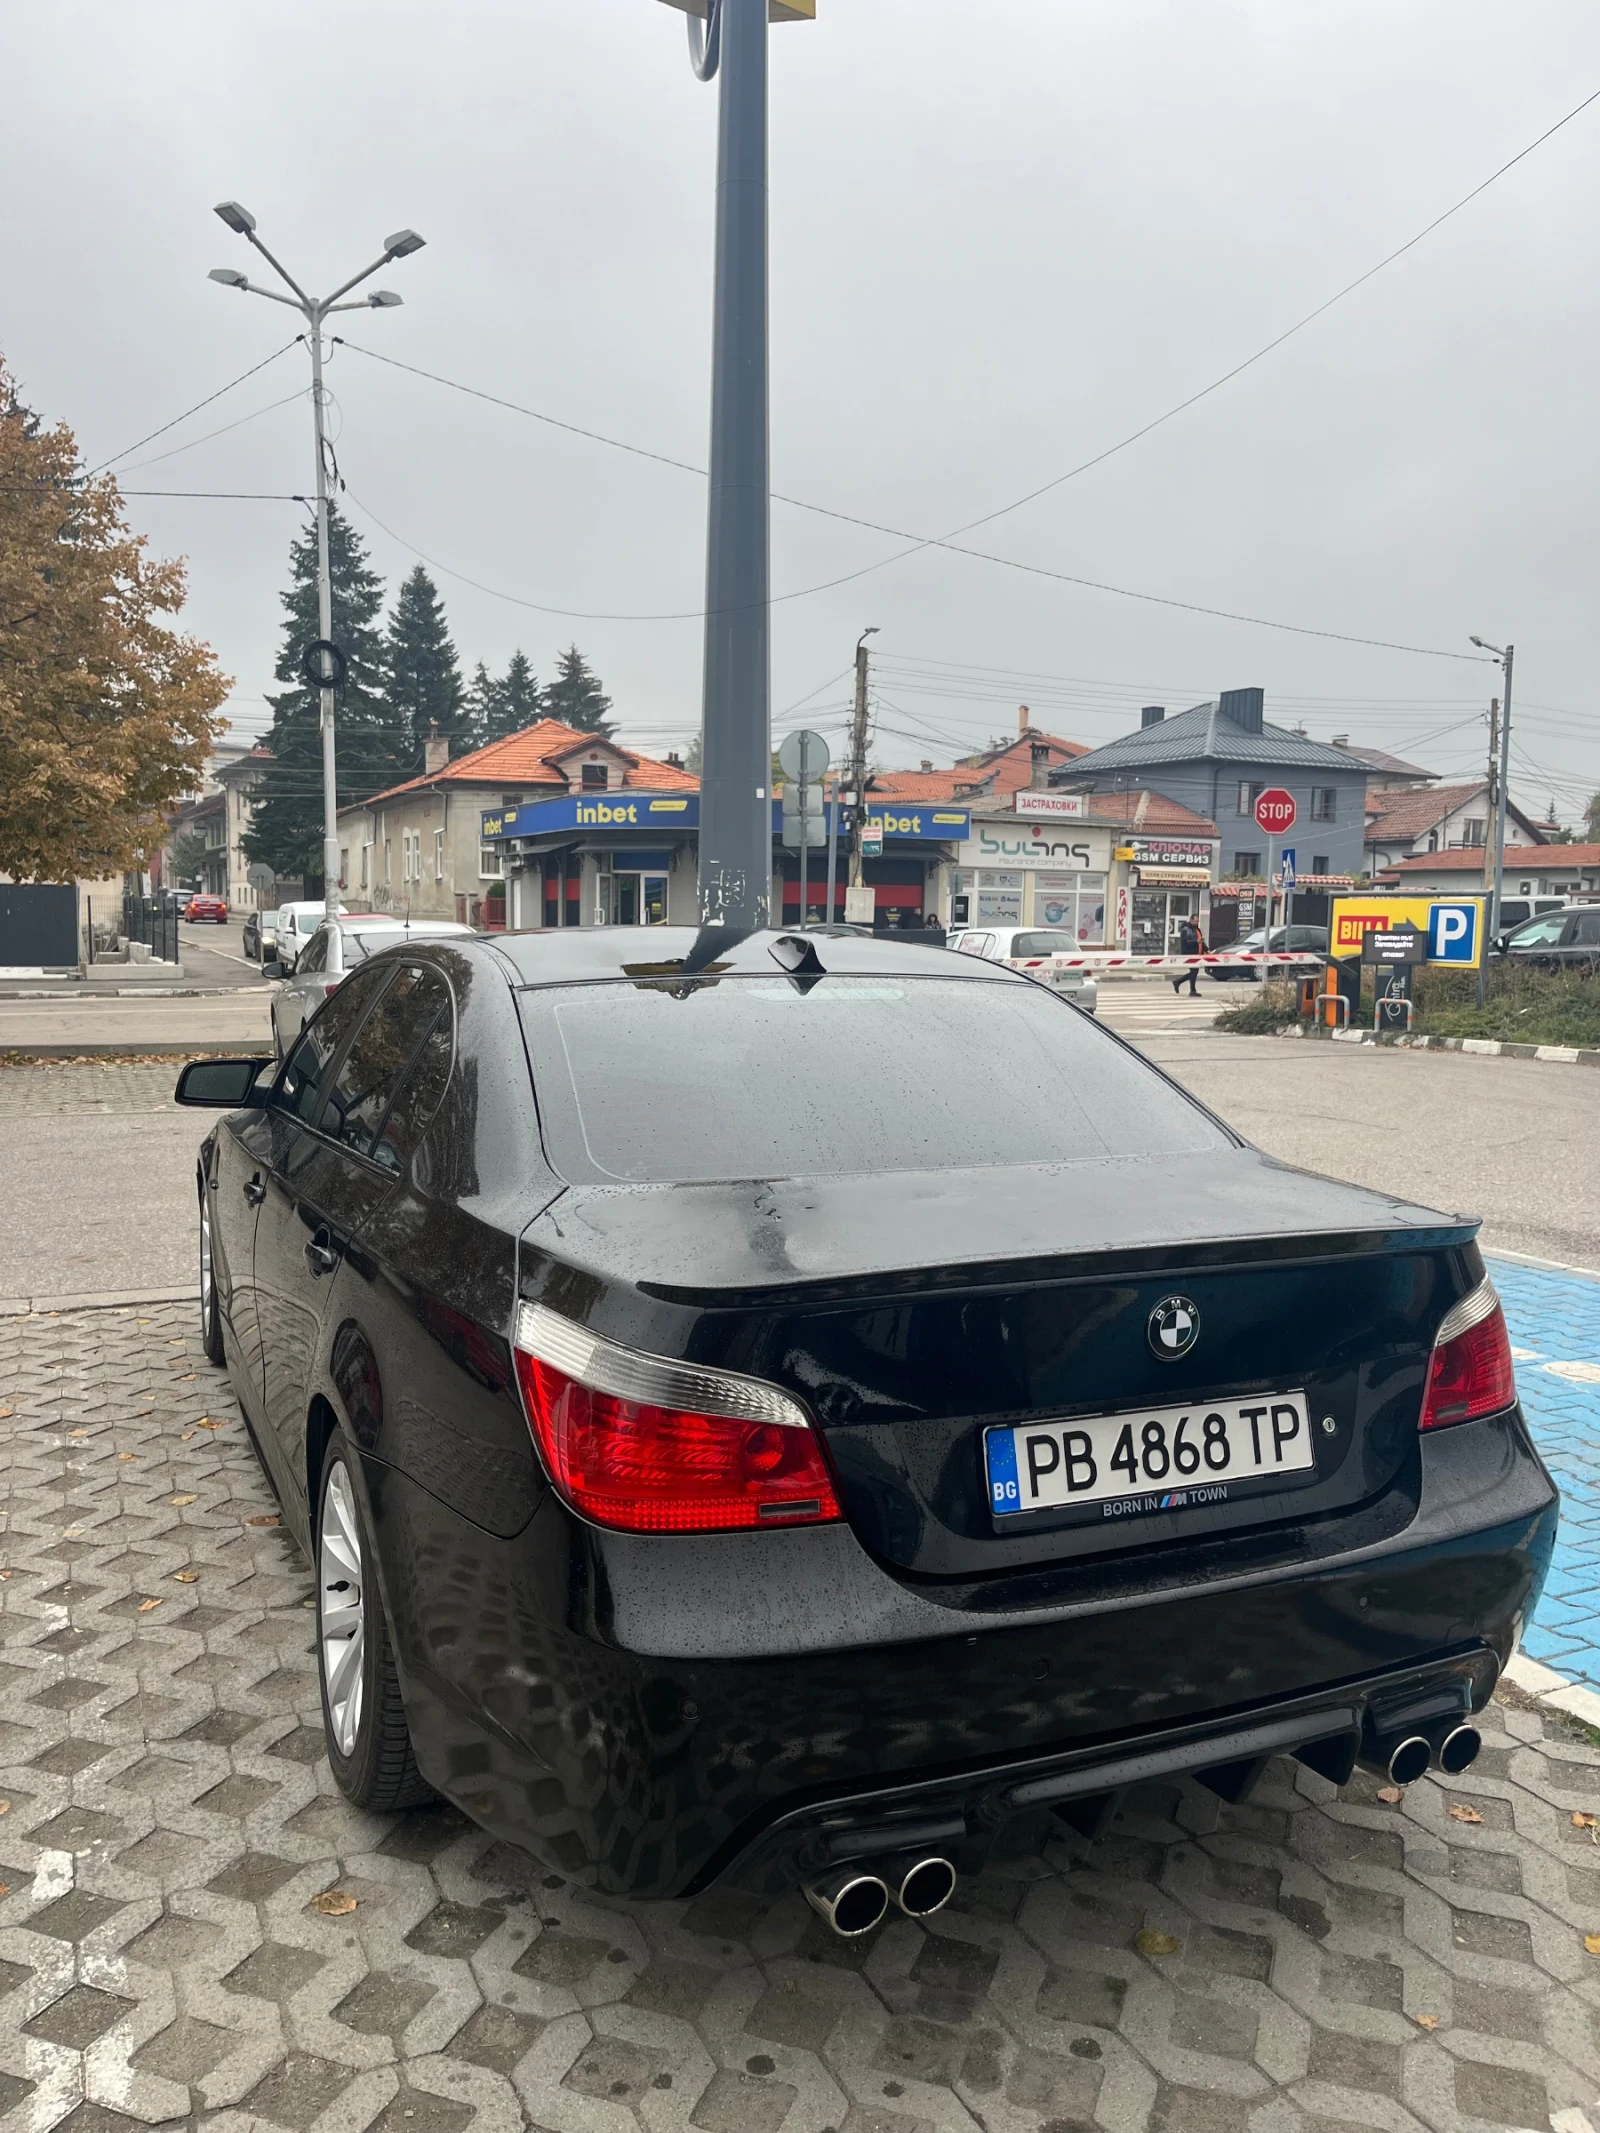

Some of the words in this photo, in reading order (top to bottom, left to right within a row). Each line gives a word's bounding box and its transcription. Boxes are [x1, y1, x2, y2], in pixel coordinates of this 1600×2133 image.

[576, 801, 637, 824] inbet
[1021, 798, 1078, 812] ЗАСТРАХОВКИ
[1259, 802, 1293, 820] STOP
[484, 817, 502, 836] inbet
[1148, 841, 1212, 854] КЛЮЧАР
[998, 857, 1036, 866] insurance
[1036, 859, 1072, 868] company
[1132, 853, 1159, 862] GSM
[1161, 854, 1209, 864] СЕРВИЗ
[1117, 889, 1127, 938] РАМКИ
[1239, 902, 1252, 911] GSM
[1435, 908, 1467, 957] P
[1155, 1299, 1196, 1321] BMW
[1025, 1430, 1098, 1498] PB
[1110, 1413, 1231, 1484] 4868
[1239, 1403, 1300, 1465] TP
[993, 1480, 1017, 1501] BG
[1103, 1501, 1142, 1517] BORN
[1144, 1497, 1159, 1511] IN
[1189, 1486, 1229, 1504] TOWN
